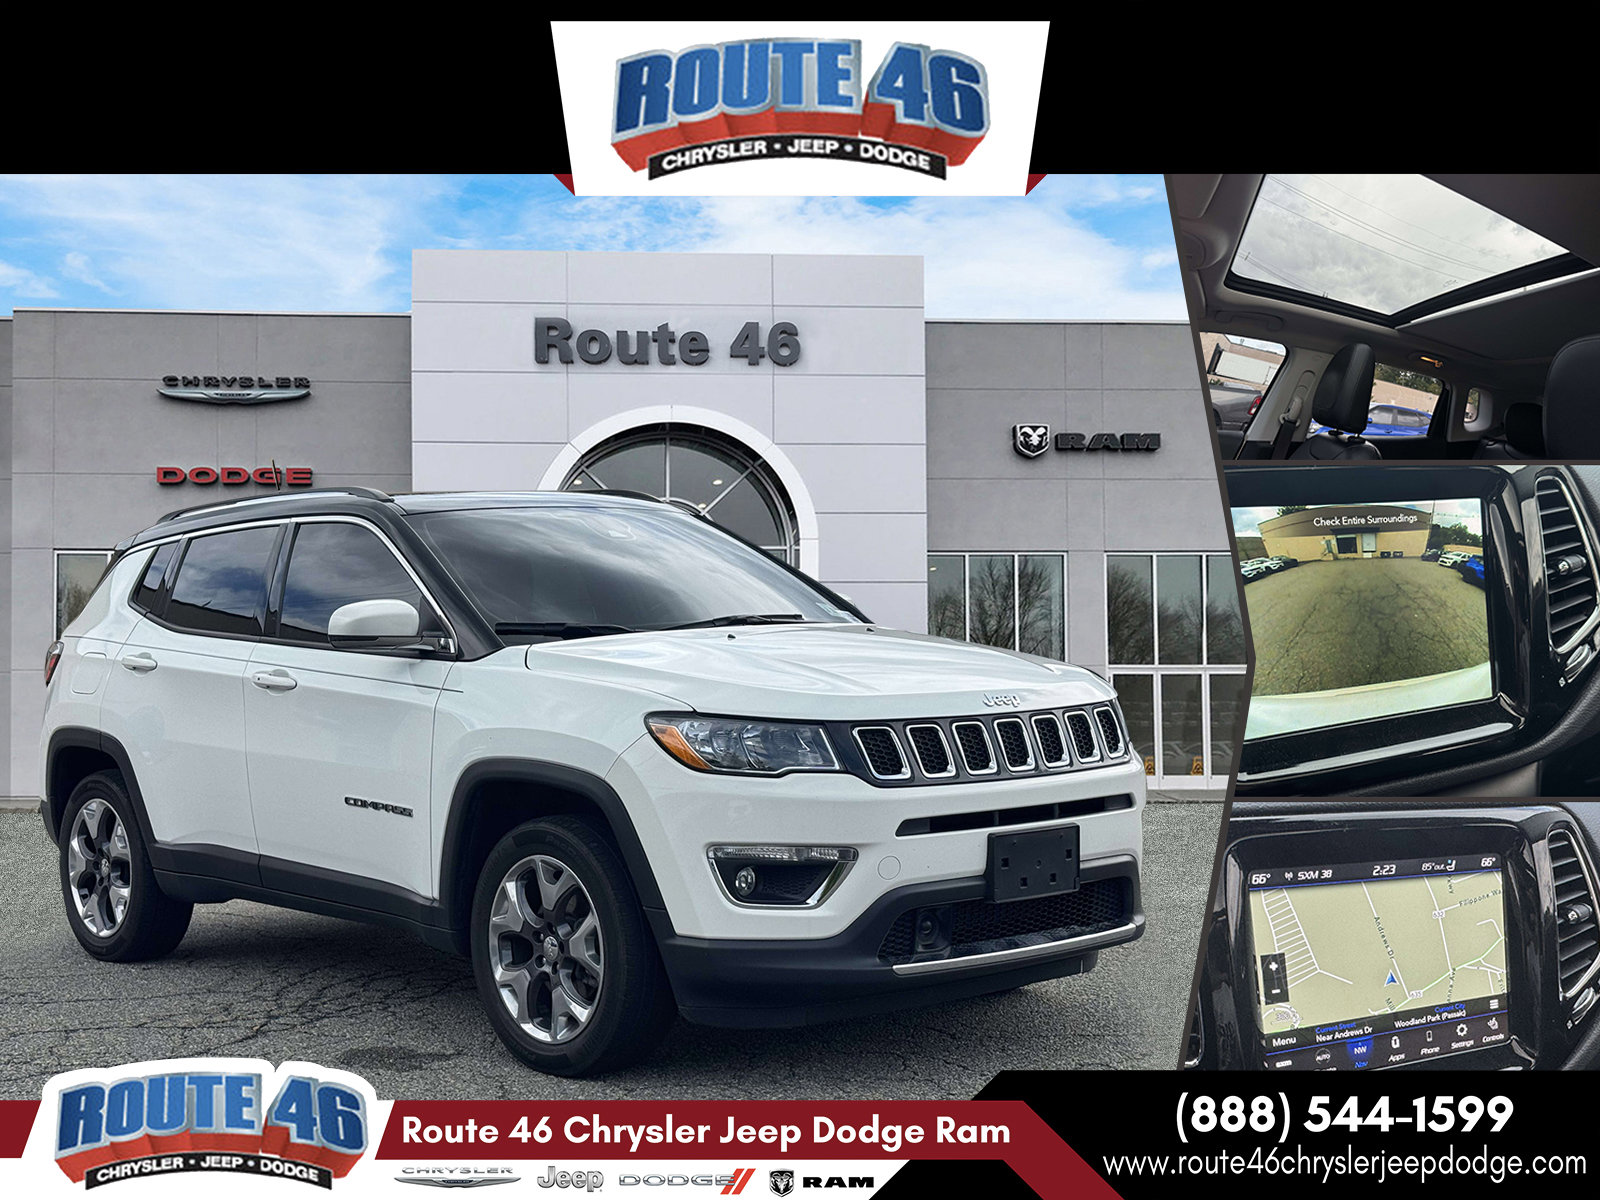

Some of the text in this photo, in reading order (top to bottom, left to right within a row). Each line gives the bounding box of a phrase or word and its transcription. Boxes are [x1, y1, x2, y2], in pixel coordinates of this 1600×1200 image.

[534, 317, 801, 367] Route 46
[162, 375, 311, 388] CHRYSLER
[1055, 432, 1161, 452] RAM
[156, 466, 313, 486] DODGE
[1313, 513, 1418, 527] Check Entire Surroundings
[982, 692, 1021, 708] Jeep
[344, 796, 414, 818] COMPASS
[1297, 869, 1333, 880] SXM 38
[1372, 864, 1397, 876] 2:23
[1374, 916, 1395, 960] Andrews Dr
[1394, 1015, 1426, 1028] Woodland
[1427, 1014, 1440, 1022] Park
[1272, 1037, 1296, 1047] Menu
[1316, 1026, 1373, 1043] Near Andrews Dr
[1388, 1053, 1405, 1062] Apps
